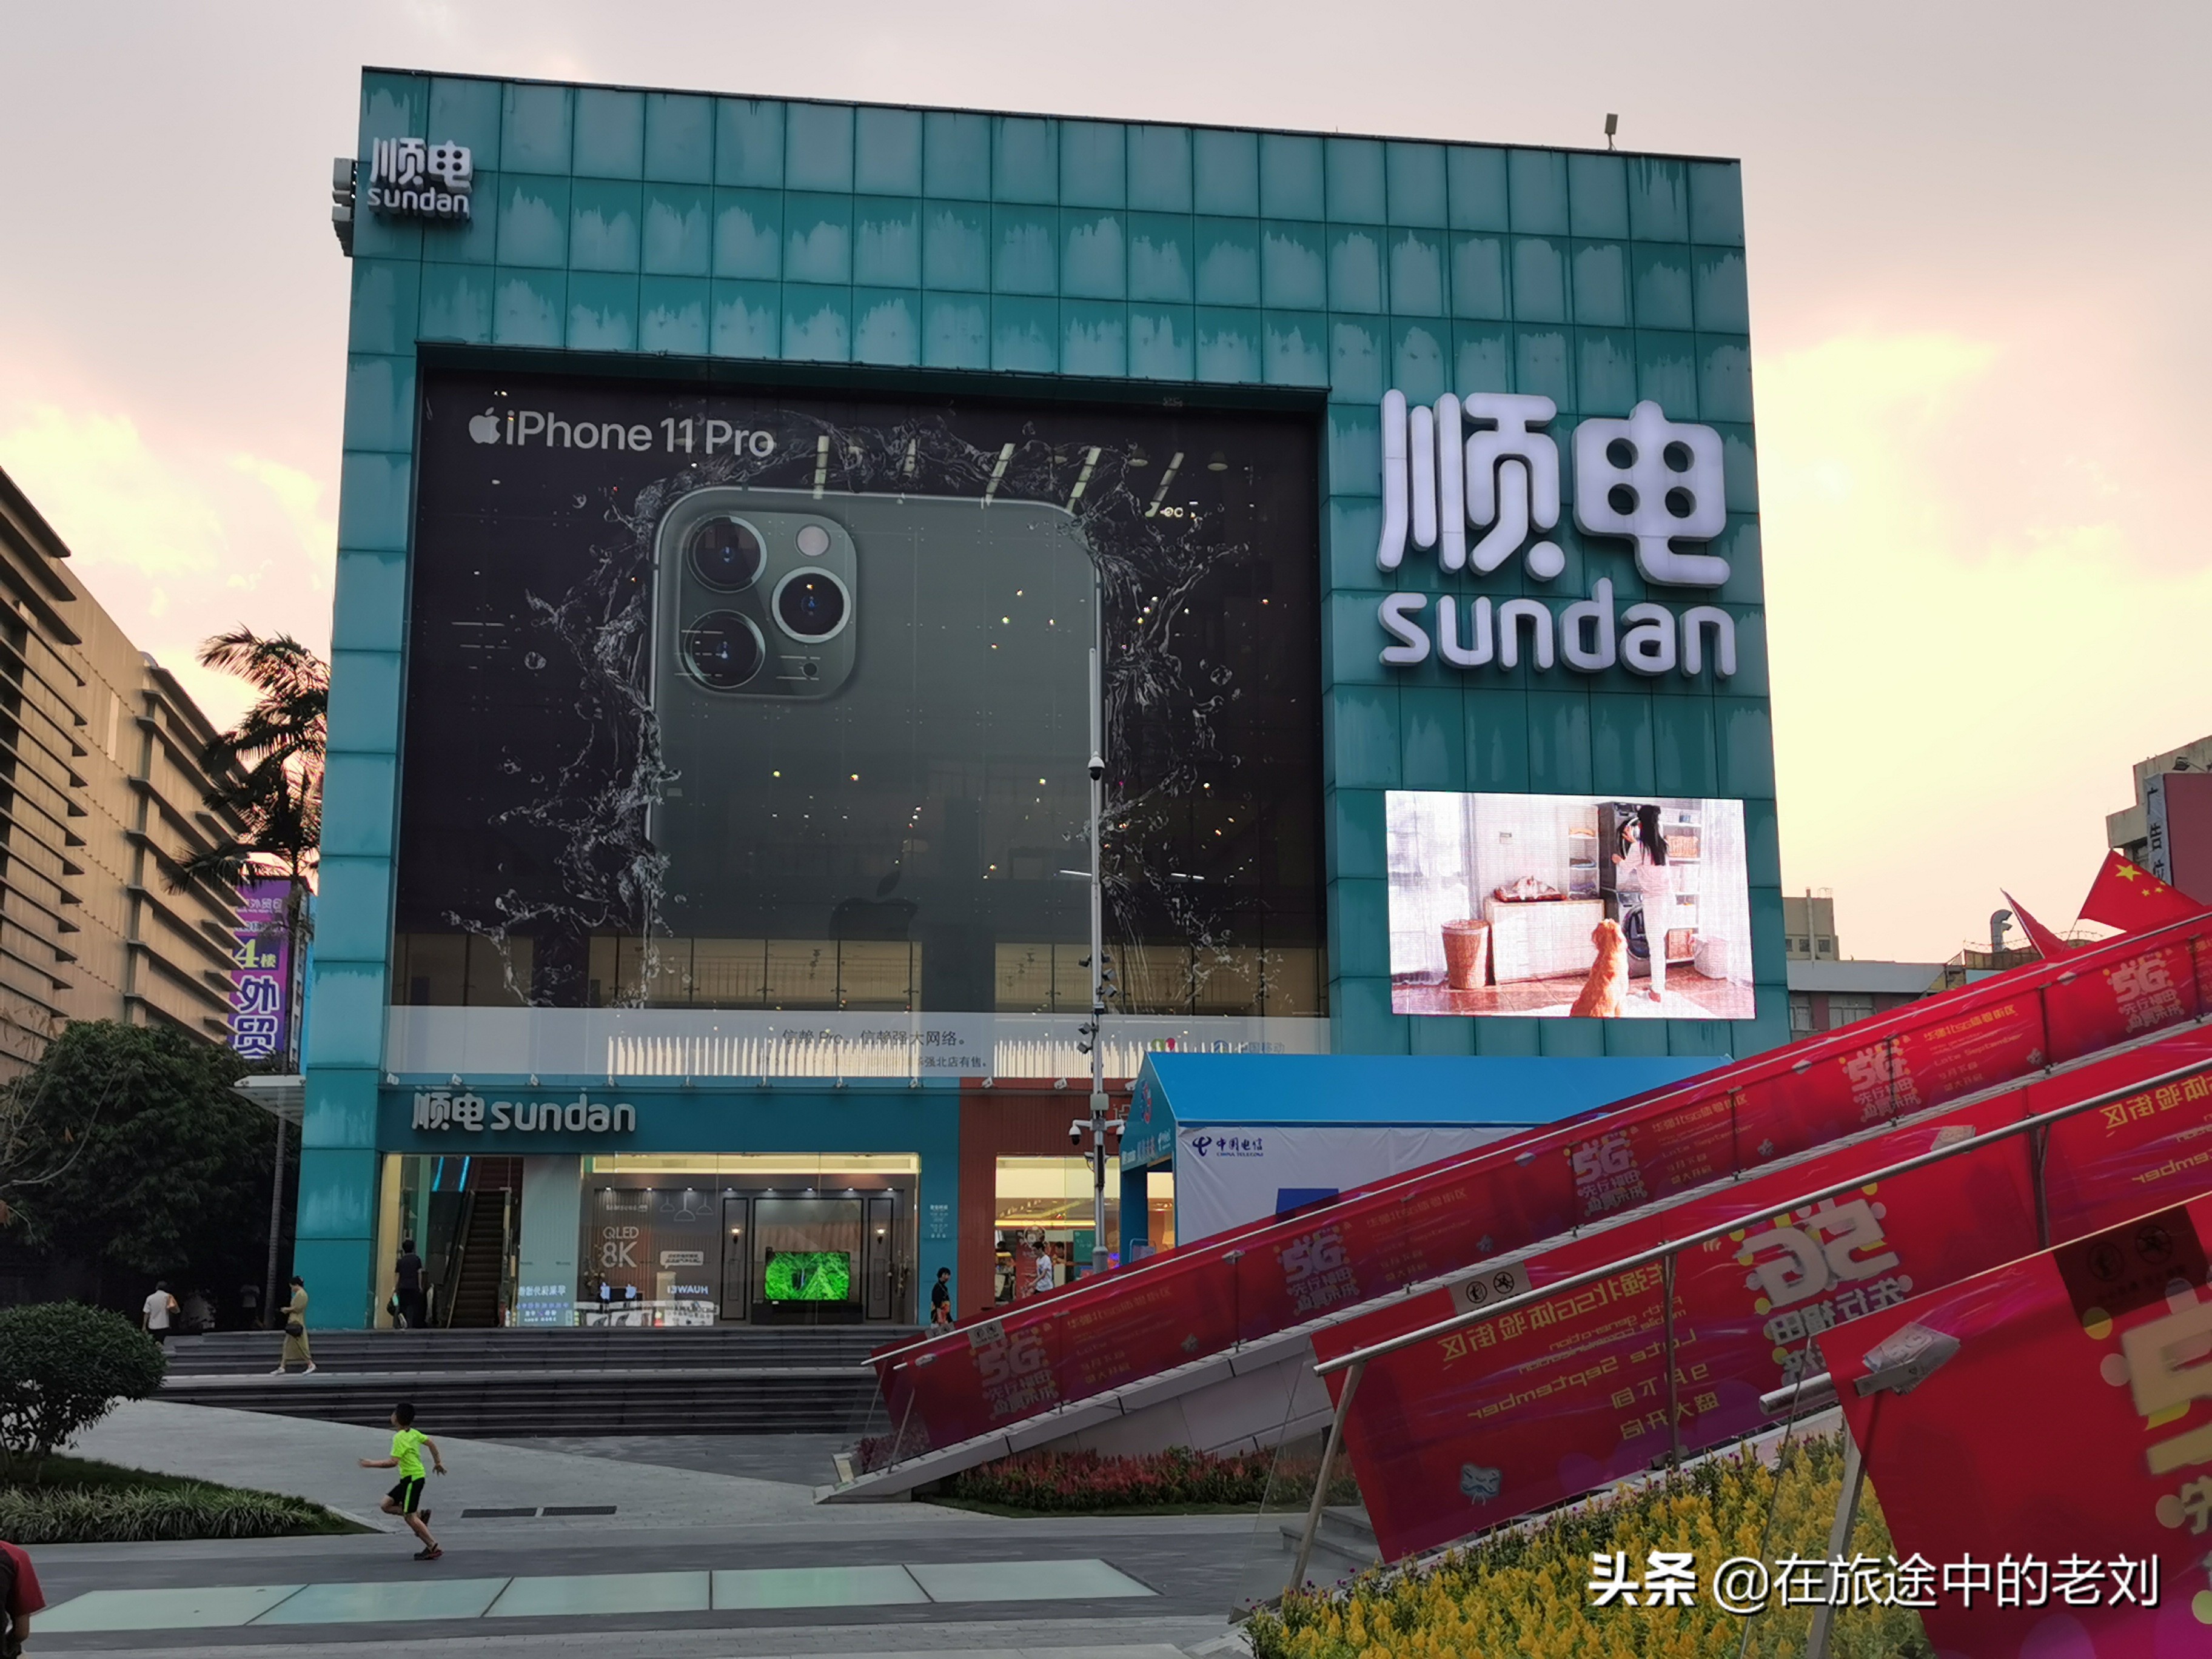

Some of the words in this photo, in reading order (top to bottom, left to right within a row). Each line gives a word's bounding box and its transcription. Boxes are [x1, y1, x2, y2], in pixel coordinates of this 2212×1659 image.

[369, 136, 472, 190] 顺电
[367, 186, 469, 217] sundan
[506, 410, 652, 451] iPhone
[660, 418, 692, 453] 11
[706, 420, 774, 457] Pro
[1376, 389, 1731, 588] 顺电
[1378, 577, 1737, 677] sundan
[2111, 958, 2167, 1004] 5G
[1964, 1033, 2023, 1056] September
[1848, 1050, 1905, 1092] 5G
[412, 1091, 484, 1131] 顺电
[490, 1093, 636, 1132] sundan
[1573, 1138, 1629, 1185] 5G
[601, 1241, 638, 1269] 8K
[603, 1226, 639, 1239] QLED
[1282, 1235, 1344, 1284] 5G
[979, 1335, 1045, 1387] 5G
